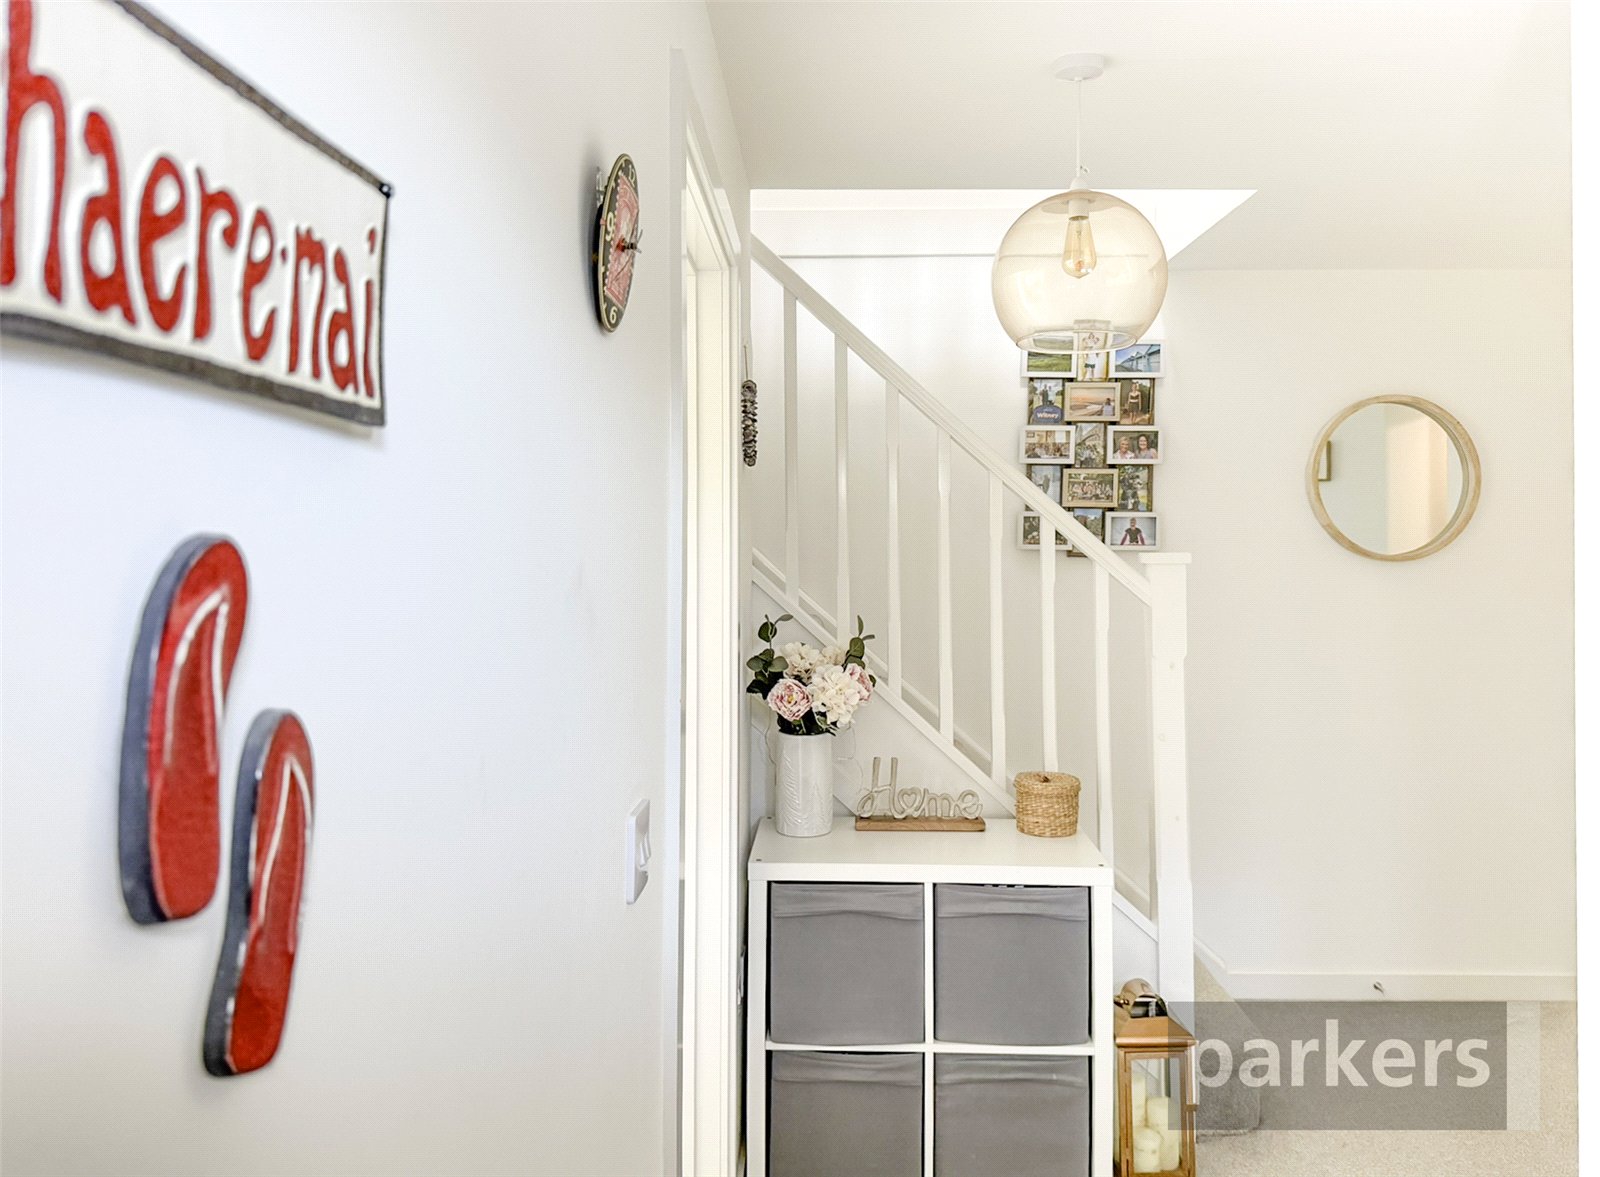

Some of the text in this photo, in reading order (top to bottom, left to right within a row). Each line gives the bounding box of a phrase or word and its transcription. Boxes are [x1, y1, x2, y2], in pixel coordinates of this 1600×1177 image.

[605, 211, 614, 241] 9
[609, 305, 618, 324] 6
[857, 756, 984, 819] Home
